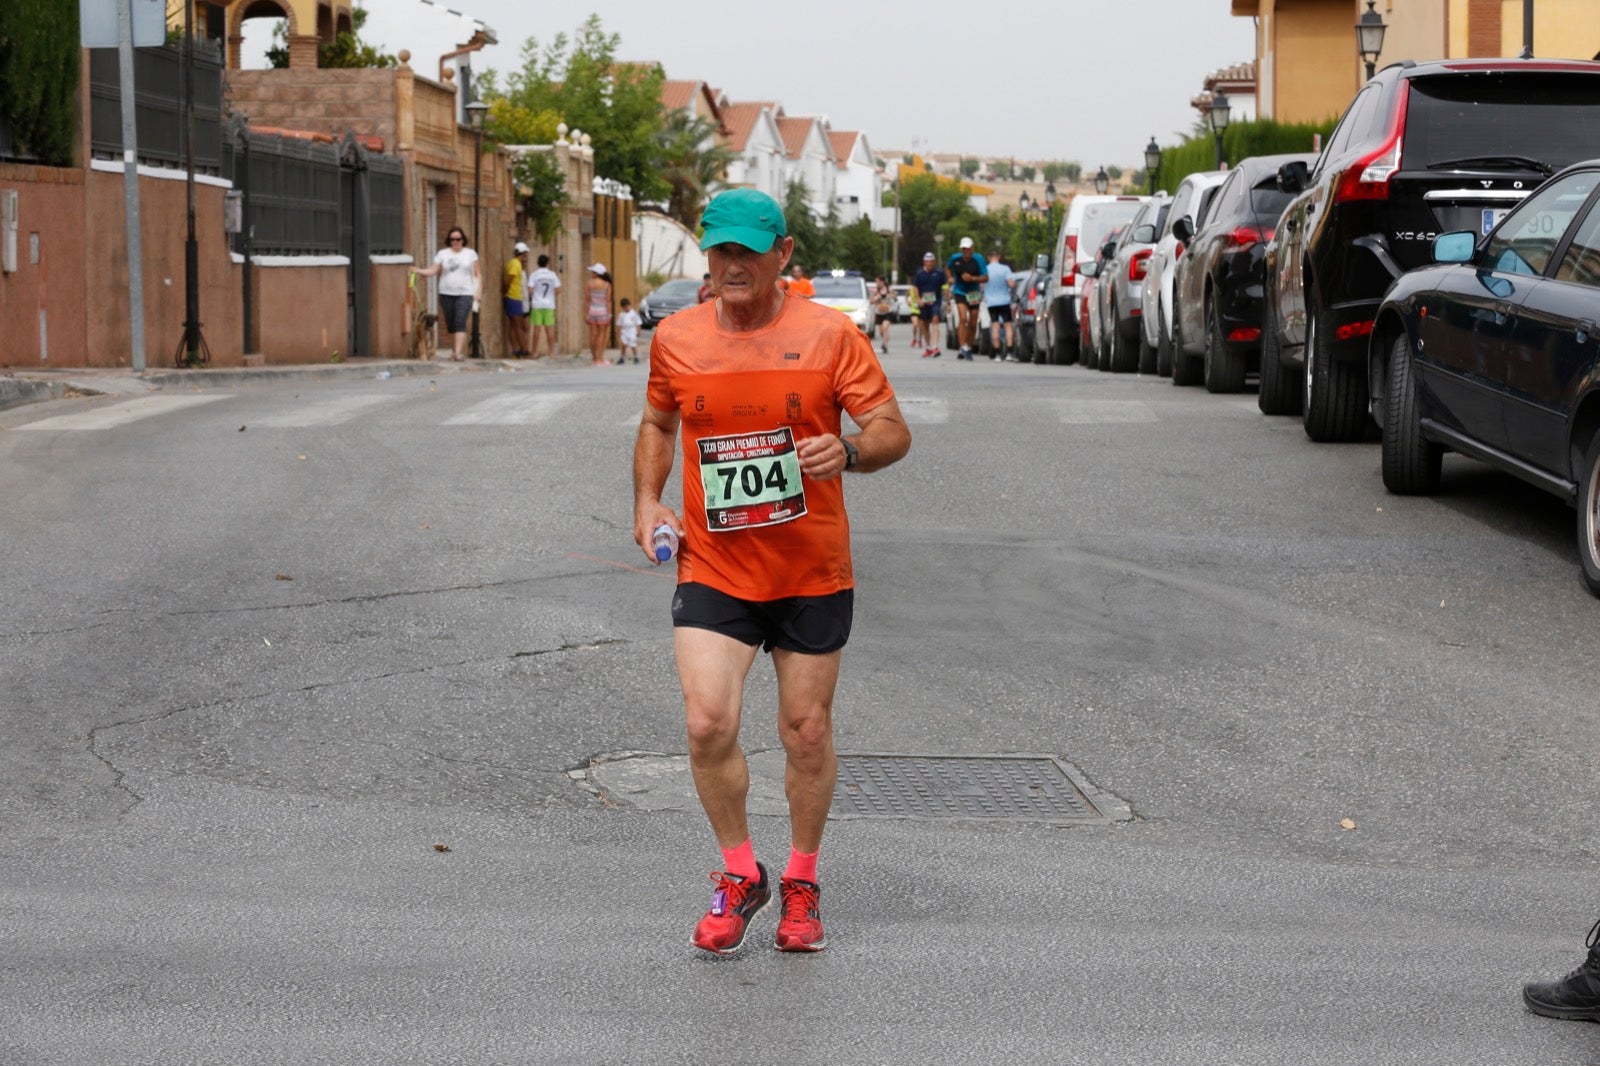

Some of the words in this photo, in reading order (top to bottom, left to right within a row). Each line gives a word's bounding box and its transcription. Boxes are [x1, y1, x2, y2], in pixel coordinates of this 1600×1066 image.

[541, 282, 550, 298] 7
[717, 439, 736, 452] GRAN
[736, 436, 759, 450] PREMIO
[759, 435, 768, 447] DE
[768, 432, 787, 446] FONDO
[746, 448, 774, 459] CRUZCAMPO
[717, 460, 788, 501] 704
